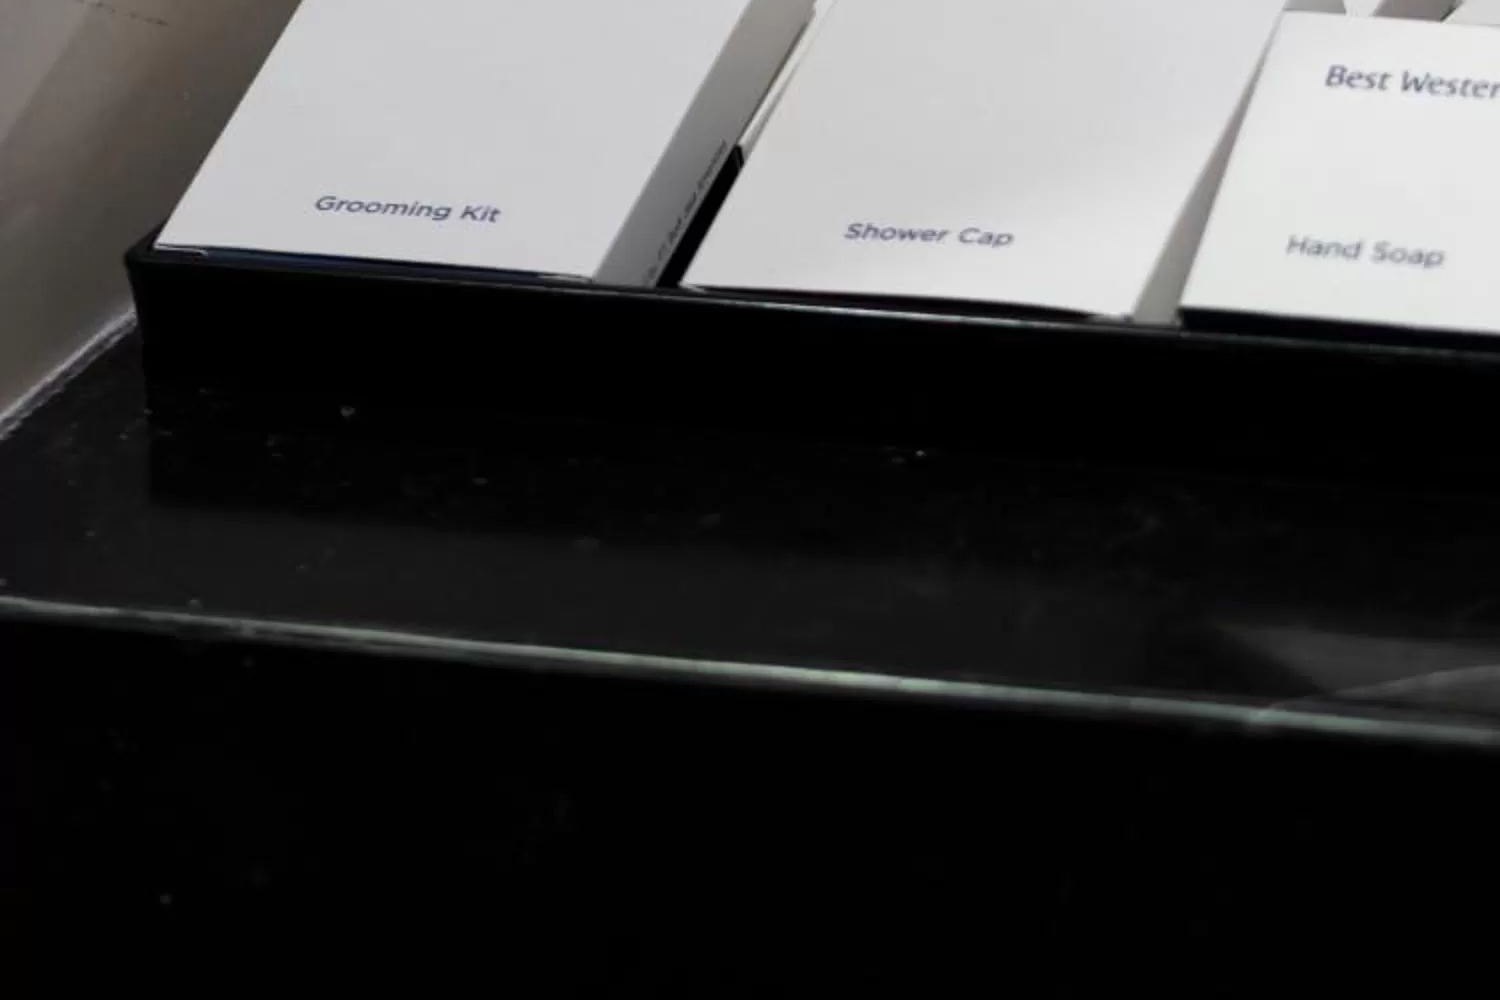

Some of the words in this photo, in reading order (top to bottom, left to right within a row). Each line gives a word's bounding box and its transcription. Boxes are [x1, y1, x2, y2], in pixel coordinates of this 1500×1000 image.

[1324, 64, 1392, 92] Best
[314, 194, 451, 222] Grooming
[459, 203, 502, 224] Kit
[843, 221, 949, 243] Shower
[957, 226, 1015, 249] Cap
[1285, 234, 1363, 261] Hand
[1371, 240, 1446, 270] Soap
